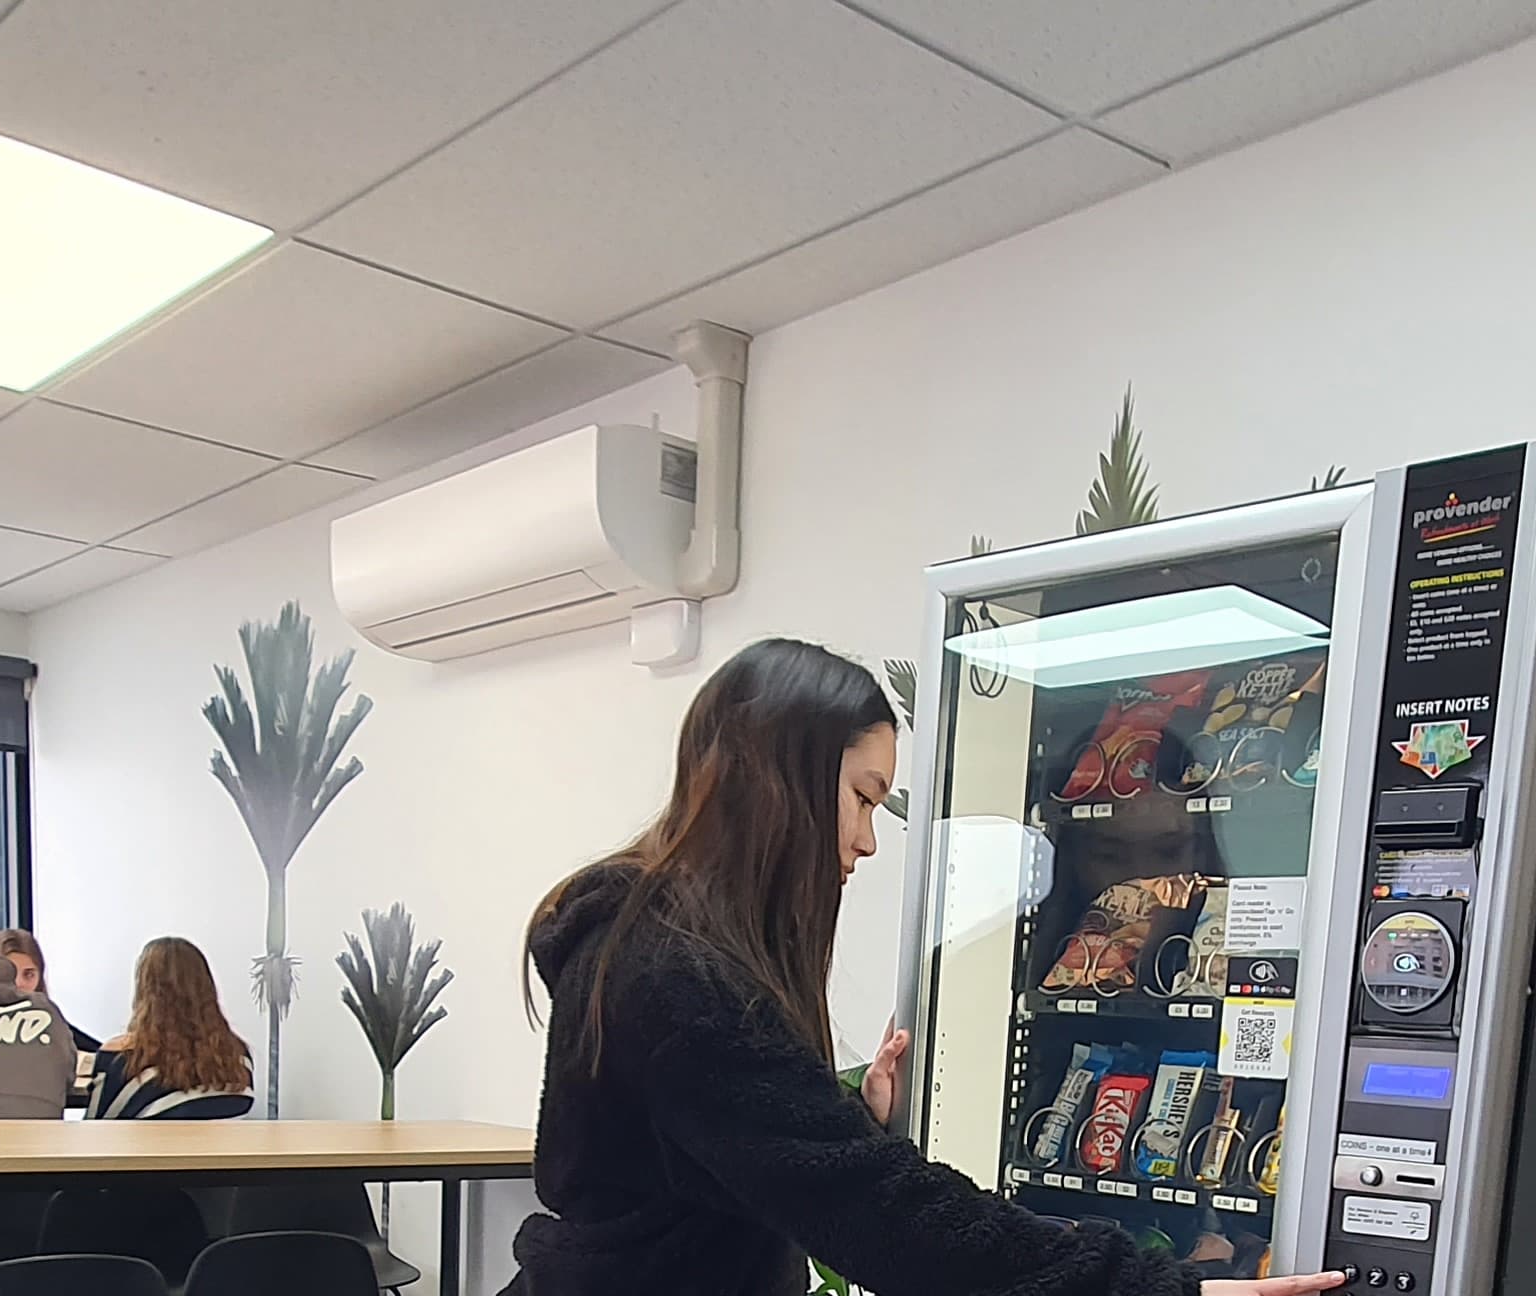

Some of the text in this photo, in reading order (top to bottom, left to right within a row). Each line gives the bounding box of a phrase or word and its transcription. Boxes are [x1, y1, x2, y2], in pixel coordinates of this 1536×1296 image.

[1413, 496, 1511, 528] provender
[1396, 695, 1490, 719] INSERT NOTES
[1096, 1095, 1128, 1153] KitKat
[1370, 1271, 1382, 1285] 2
[1398, 1274, 1409, 1289] 3
